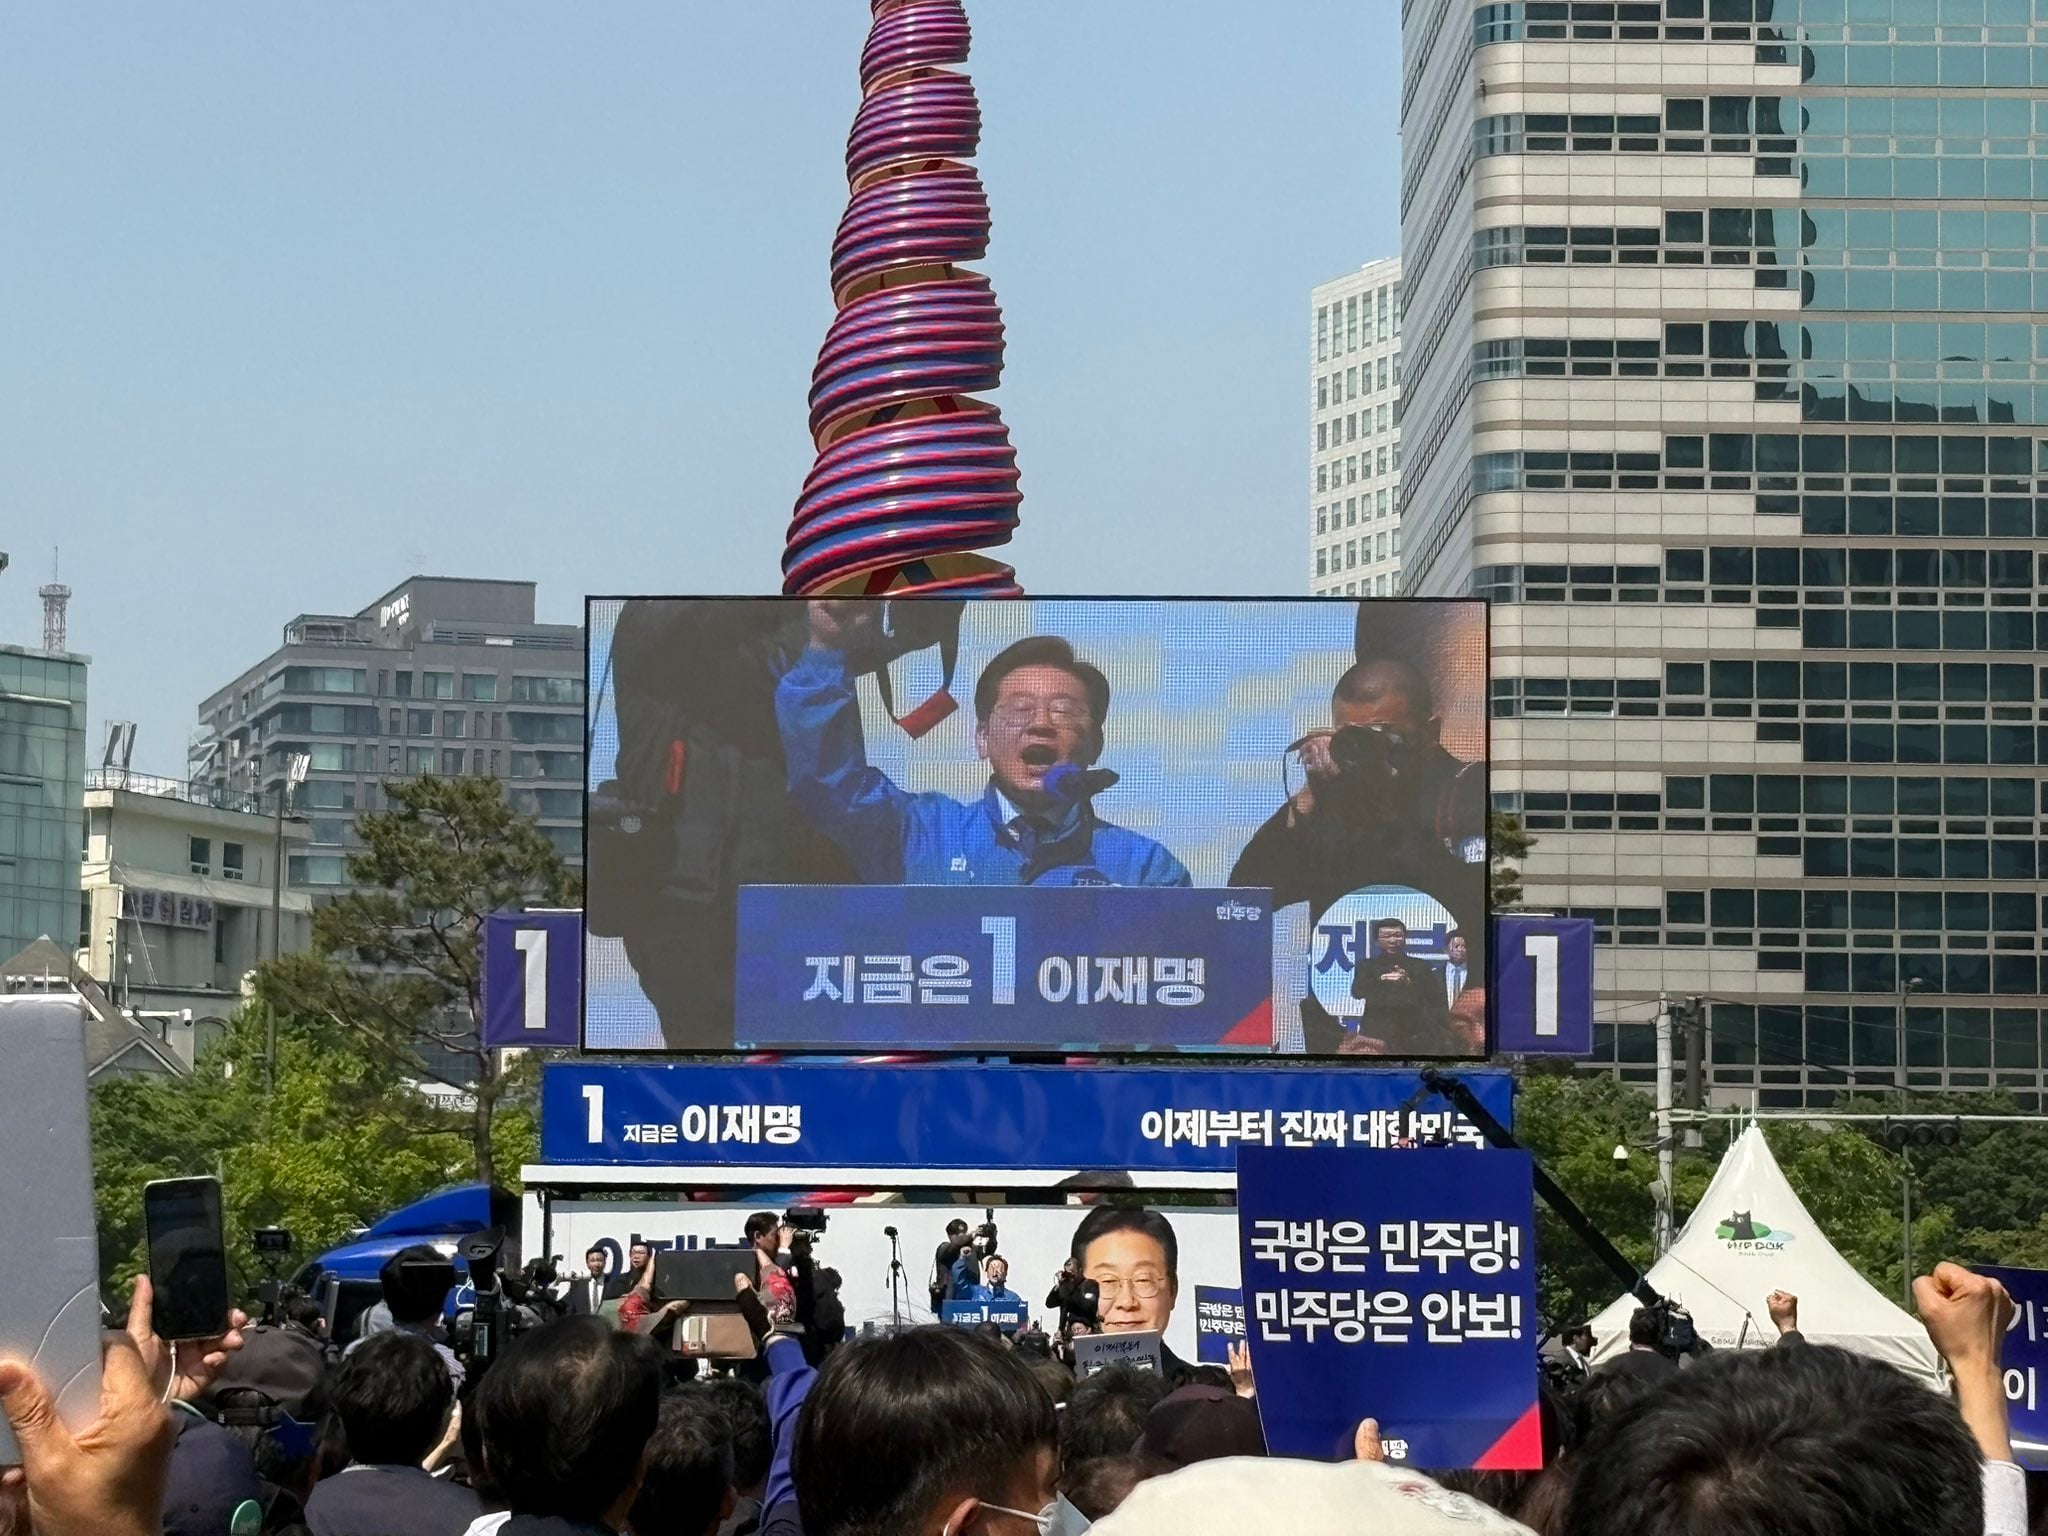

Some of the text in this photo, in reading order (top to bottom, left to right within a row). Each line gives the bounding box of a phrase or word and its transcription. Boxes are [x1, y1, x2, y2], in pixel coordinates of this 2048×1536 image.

[515, 929, 547, 1029] 1
[803, 916, 1205, 1005] 지금은 1 이재명
[1525, 935, 1558, 1036] 1
[582, 1085, 801, 1144] 1 지금은 이재명
[1141, 1108, 1274, 1148] 이제부터
[1280, 1109, 1348, 1147] 진짜
[1250, 1219, 1520, 1274] 국방은 민주당!
[1198, 1302, 1233, 1318] 국방은
[1255, 1288, 1521, 1343] 민주당은 안보!
